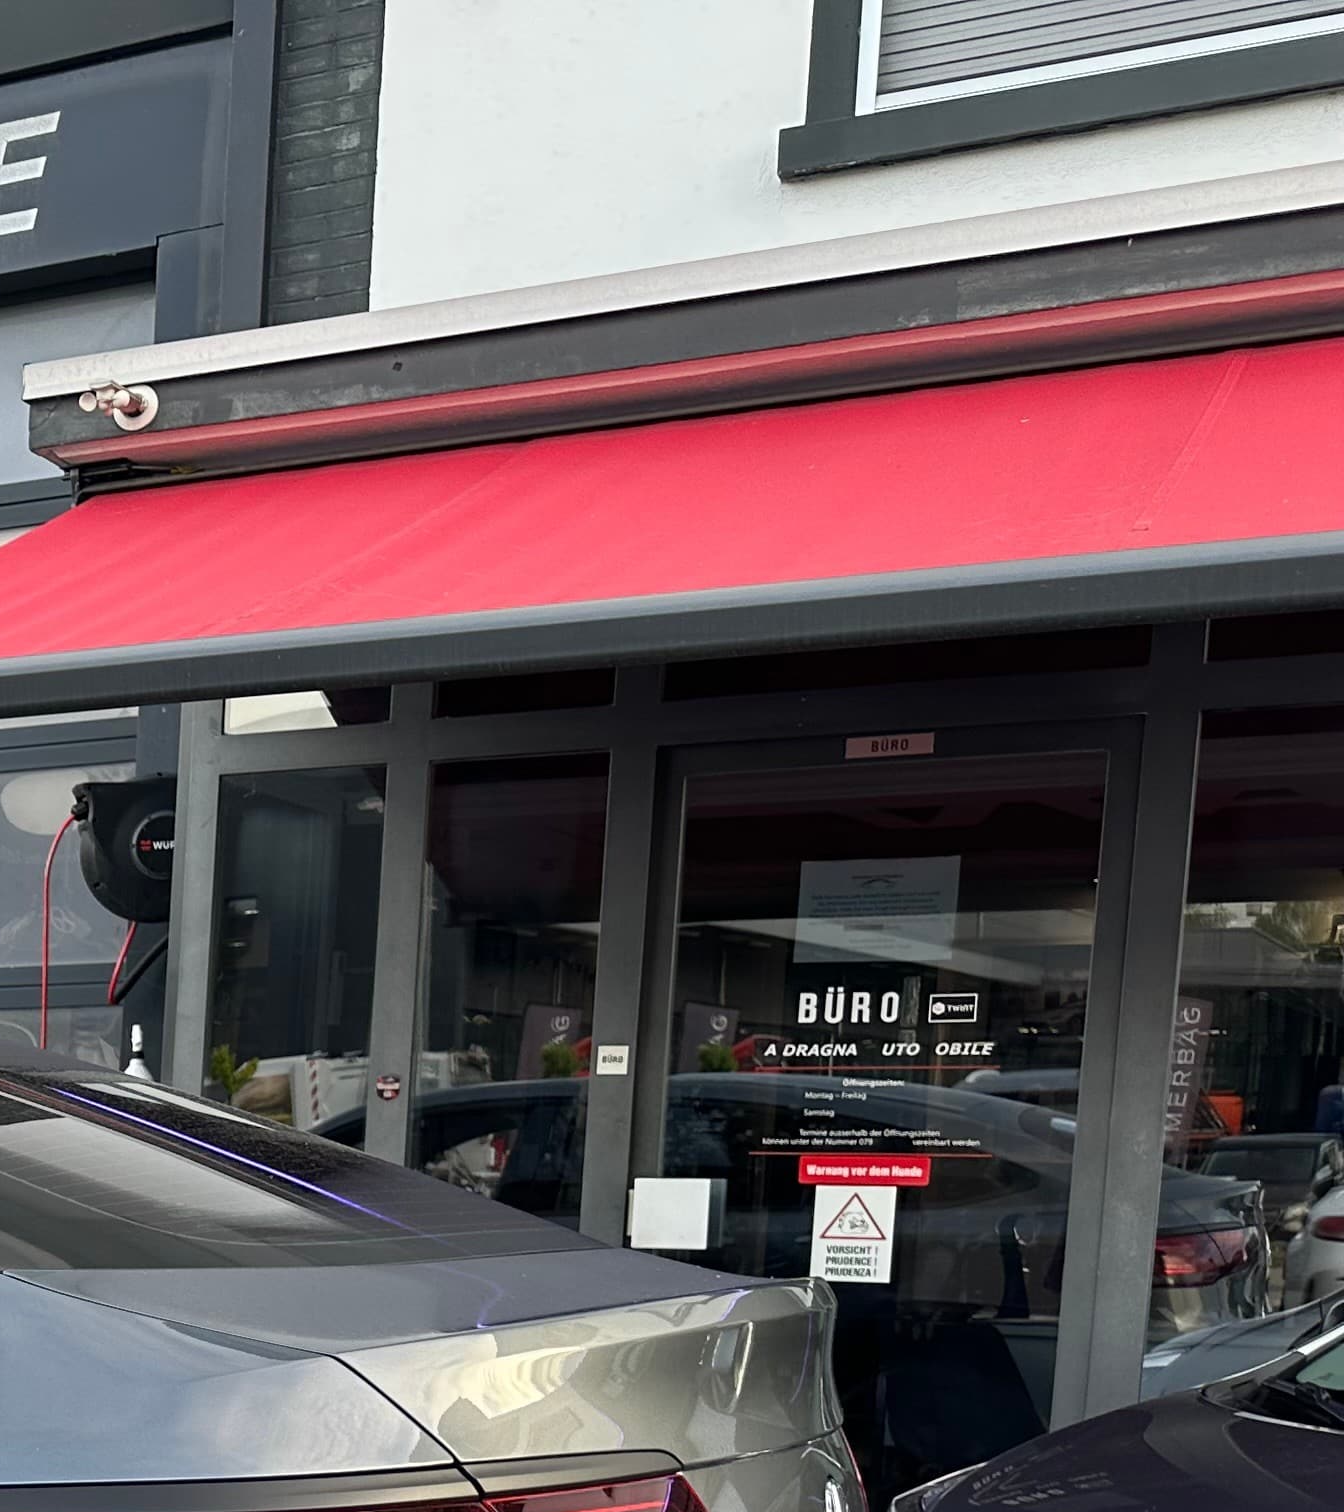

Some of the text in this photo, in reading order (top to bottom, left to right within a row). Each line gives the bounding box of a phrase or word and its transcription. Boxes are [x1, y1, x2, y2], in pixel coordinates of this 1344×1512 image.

[797, 987, 900, 1024] BÜRO
[1164, 1007, 1201, 1132] MERBAG
[804, 1091, 834, 1100] Montag
[803, 1108, 835, 1118] Samstag
[851, 1166, 868, 1177] vor
[869, 1165, 890, 1177] dem
[891, 1165, 923, 1178] Hunde
[826, 1245, 872, 1255] VORSICHT
[825, 1256, 872, 1266] PRUDENCE
